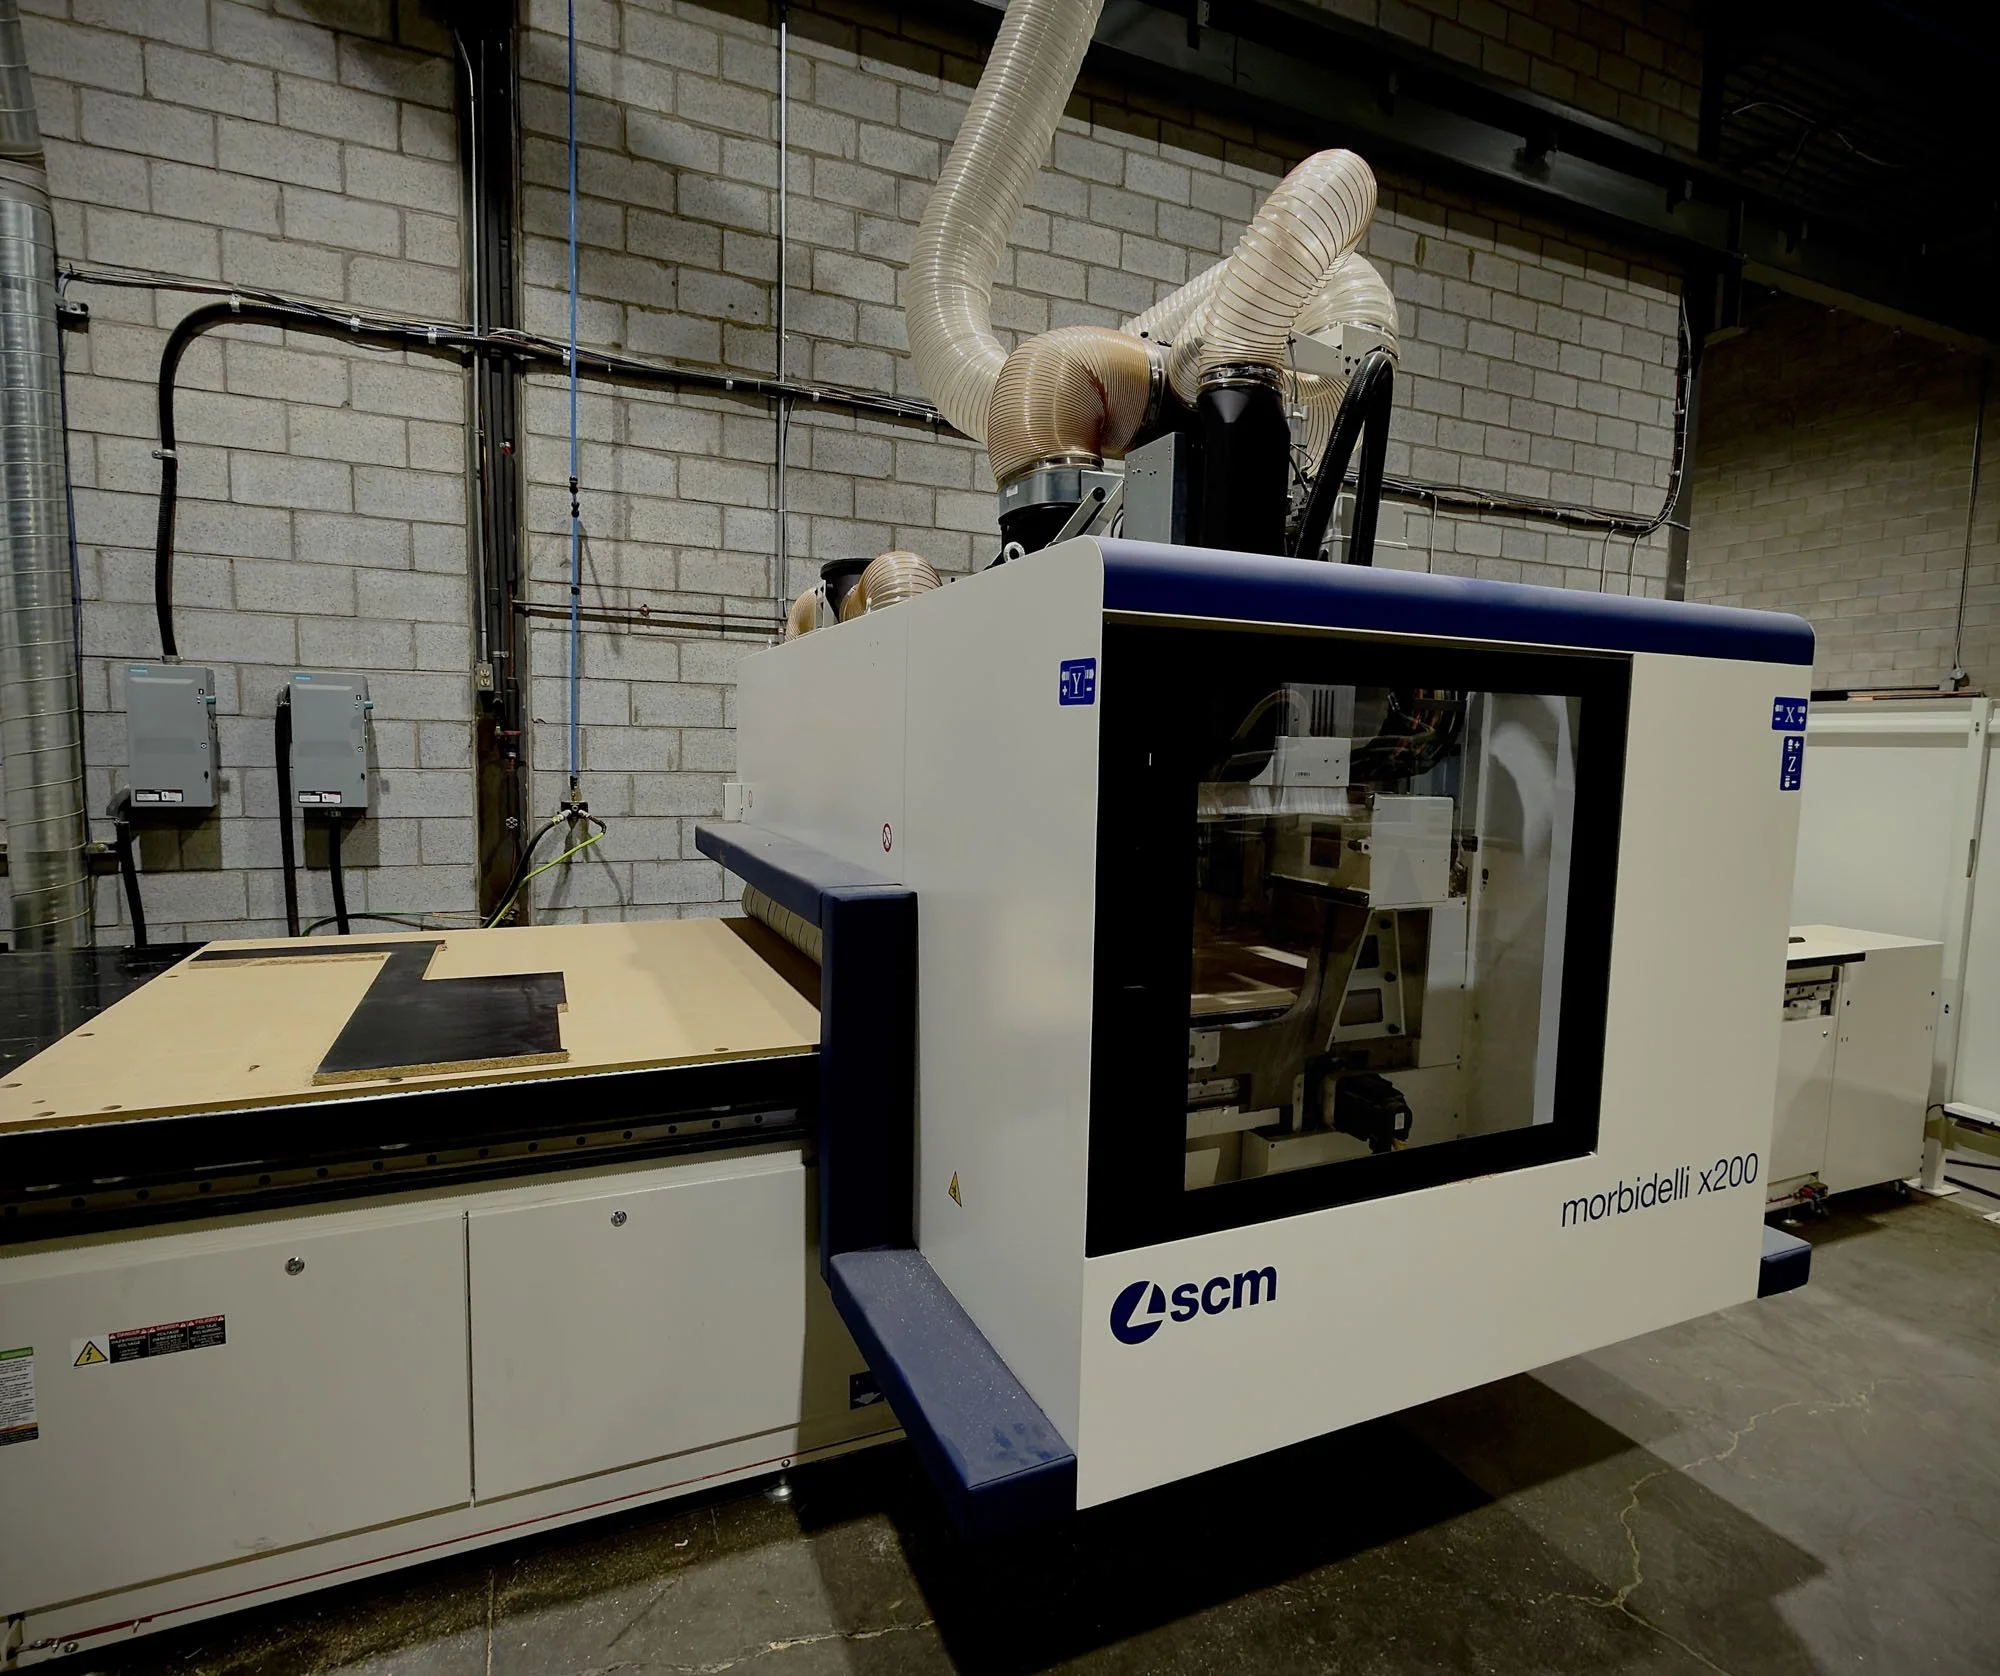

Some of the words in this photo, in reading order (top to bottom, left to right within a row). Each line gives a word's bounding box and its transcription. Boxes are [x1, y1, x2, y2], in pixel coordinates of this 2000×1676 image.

[1072, 672, 1082, 695] Y
[1784, 706, 1795, 723] X
[1787, 756, 1797, 772] Z
[1561, 1165, 1690, 1228] morbidelli
[1697, 1152, 1759, 1195] x200
[1170, 1266, 1277, 1323] scm
